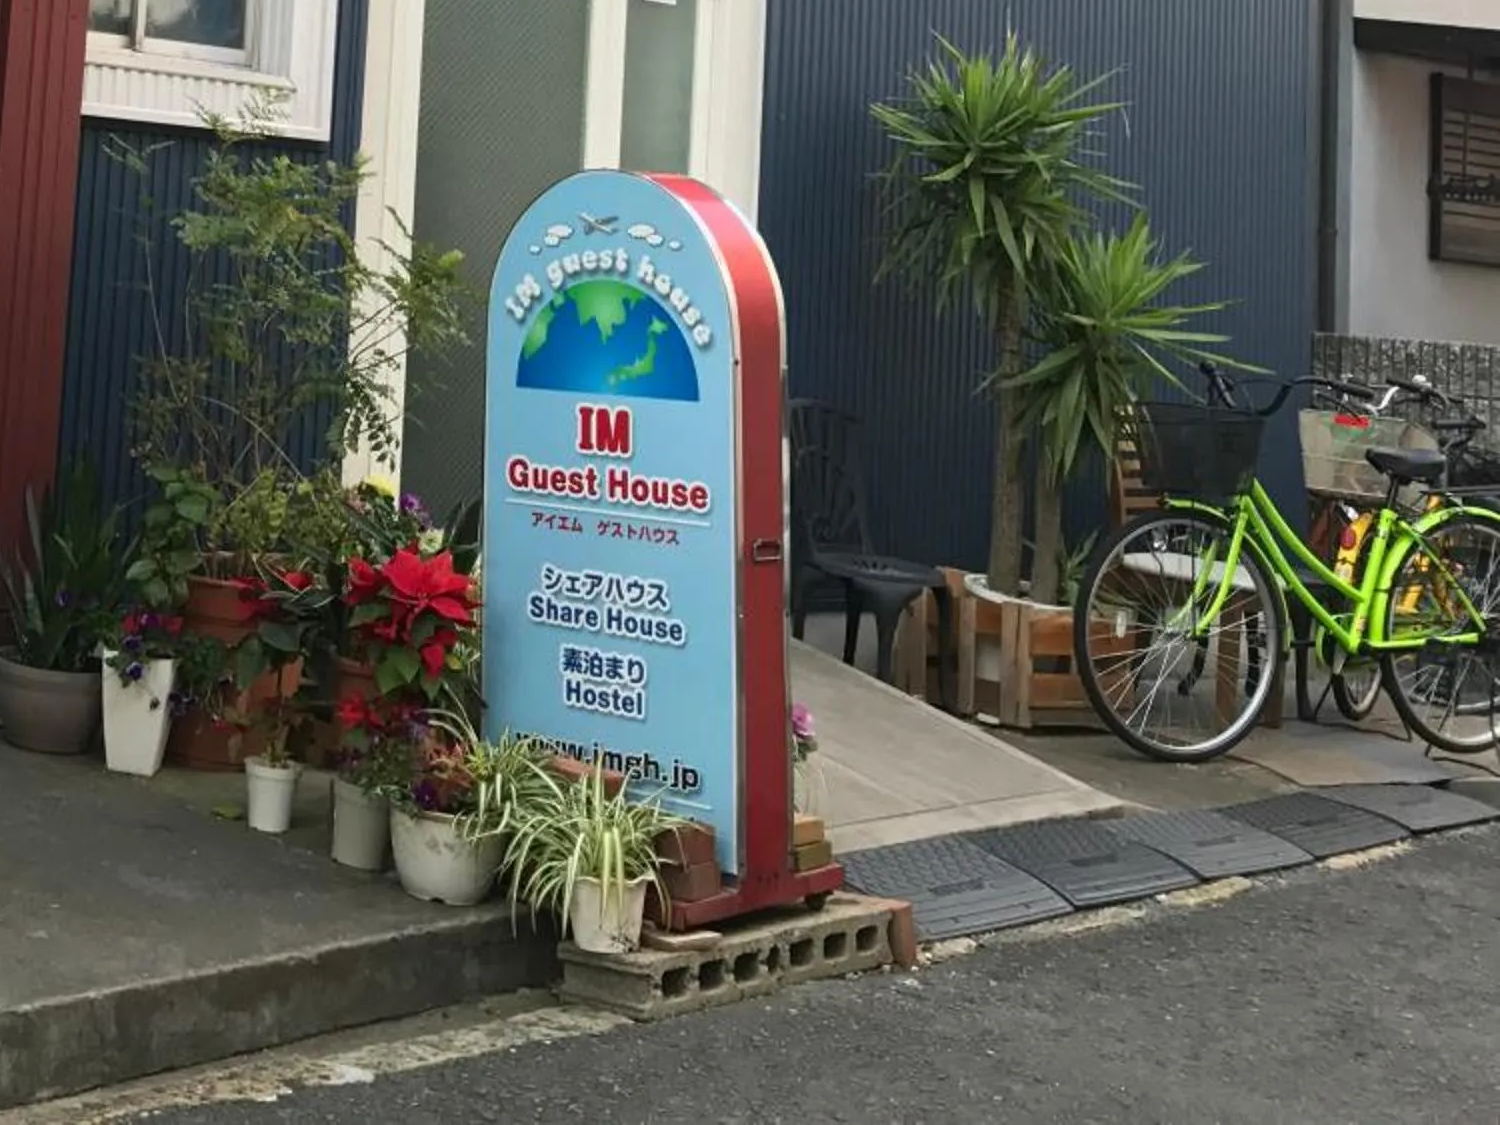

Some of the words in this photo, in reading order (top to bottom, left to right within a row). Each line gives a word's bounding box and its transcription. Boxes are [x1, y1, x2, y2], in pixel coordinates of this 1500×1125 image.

[546, 247, 629, 289] guest
[637, 255, 712, 346] house
[577, 405, 631, 455] IM
[507, 457, 598, 496] Guest
[607, 467, 709, 509] House
[531, 511, 583, 533] アイエム
[596, 520, 680, 546] ゲストハウス
[543, 566, 668, 608] シェアハウス
[529, 595, 599, 627] Share
[606, 607, 684, 642] House
[562, 647, 645, 685] 素泊まり
[565, 678, 643, 715] Hostel
